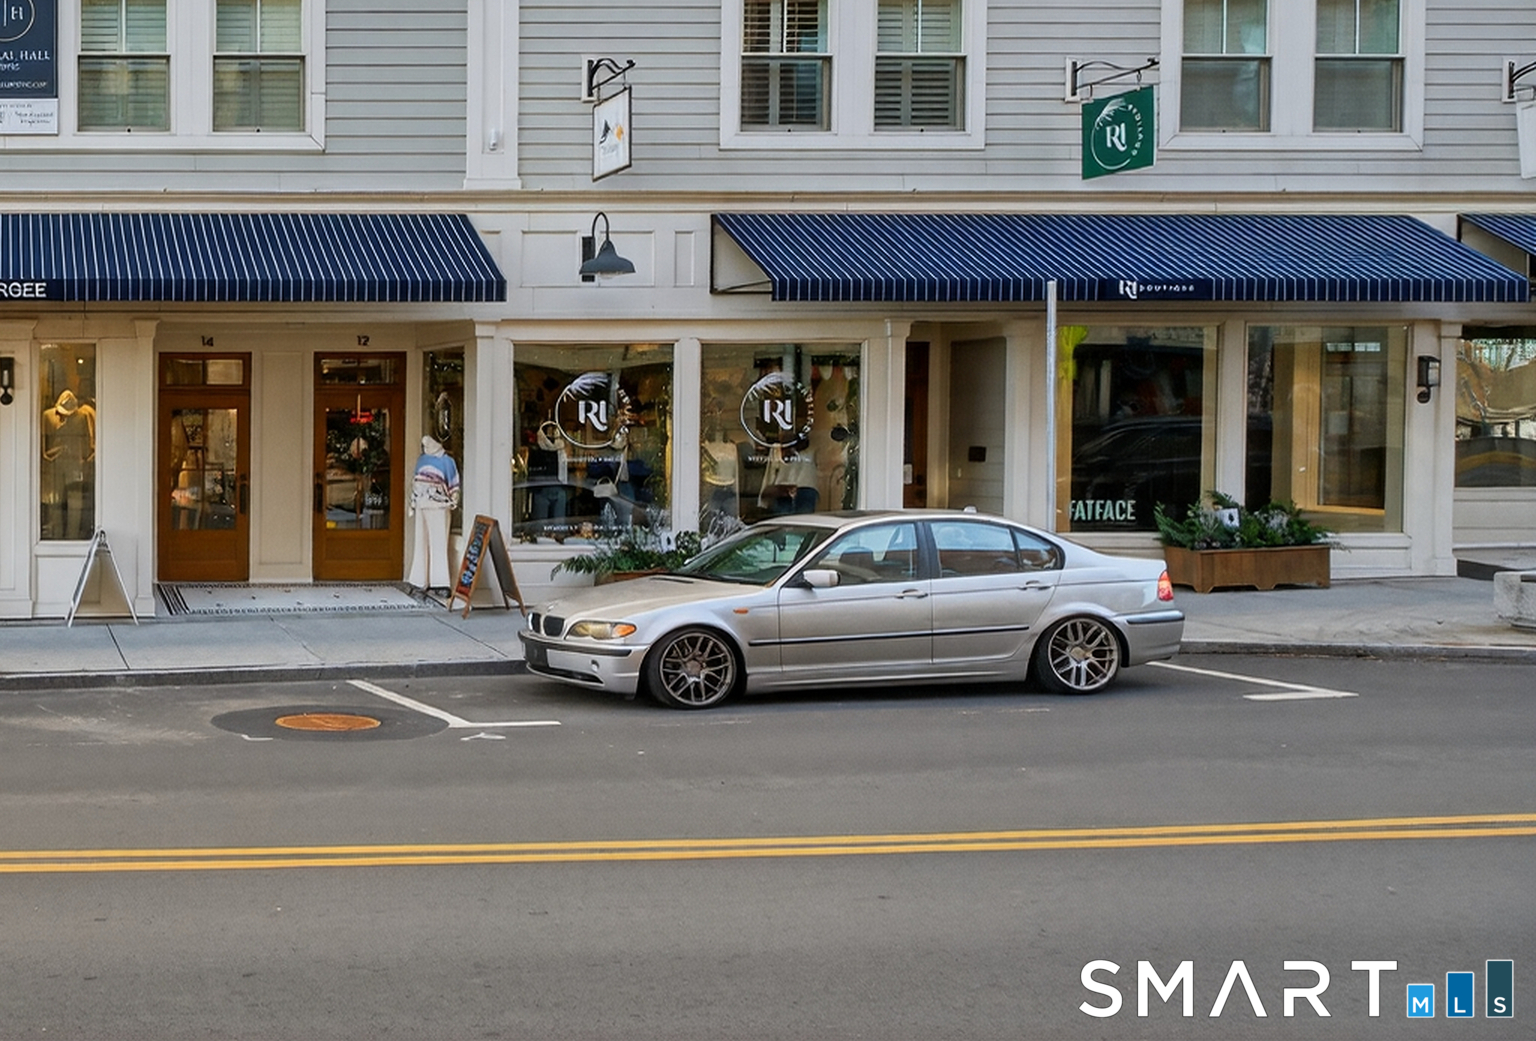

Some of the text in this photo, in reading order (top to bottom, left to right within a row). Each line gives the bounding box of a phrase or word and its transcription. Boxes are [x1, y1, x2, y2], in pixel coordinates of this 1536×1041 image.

[20, 50, 50, 61] HALL
[1106, 123, 1127, 152] RI
[357, 335, 370, 346] 12
[578, 400, 608, 432] RI
[764, 399, 793, 430] RI
[1068, 500, 1136, 521] FATFACE
